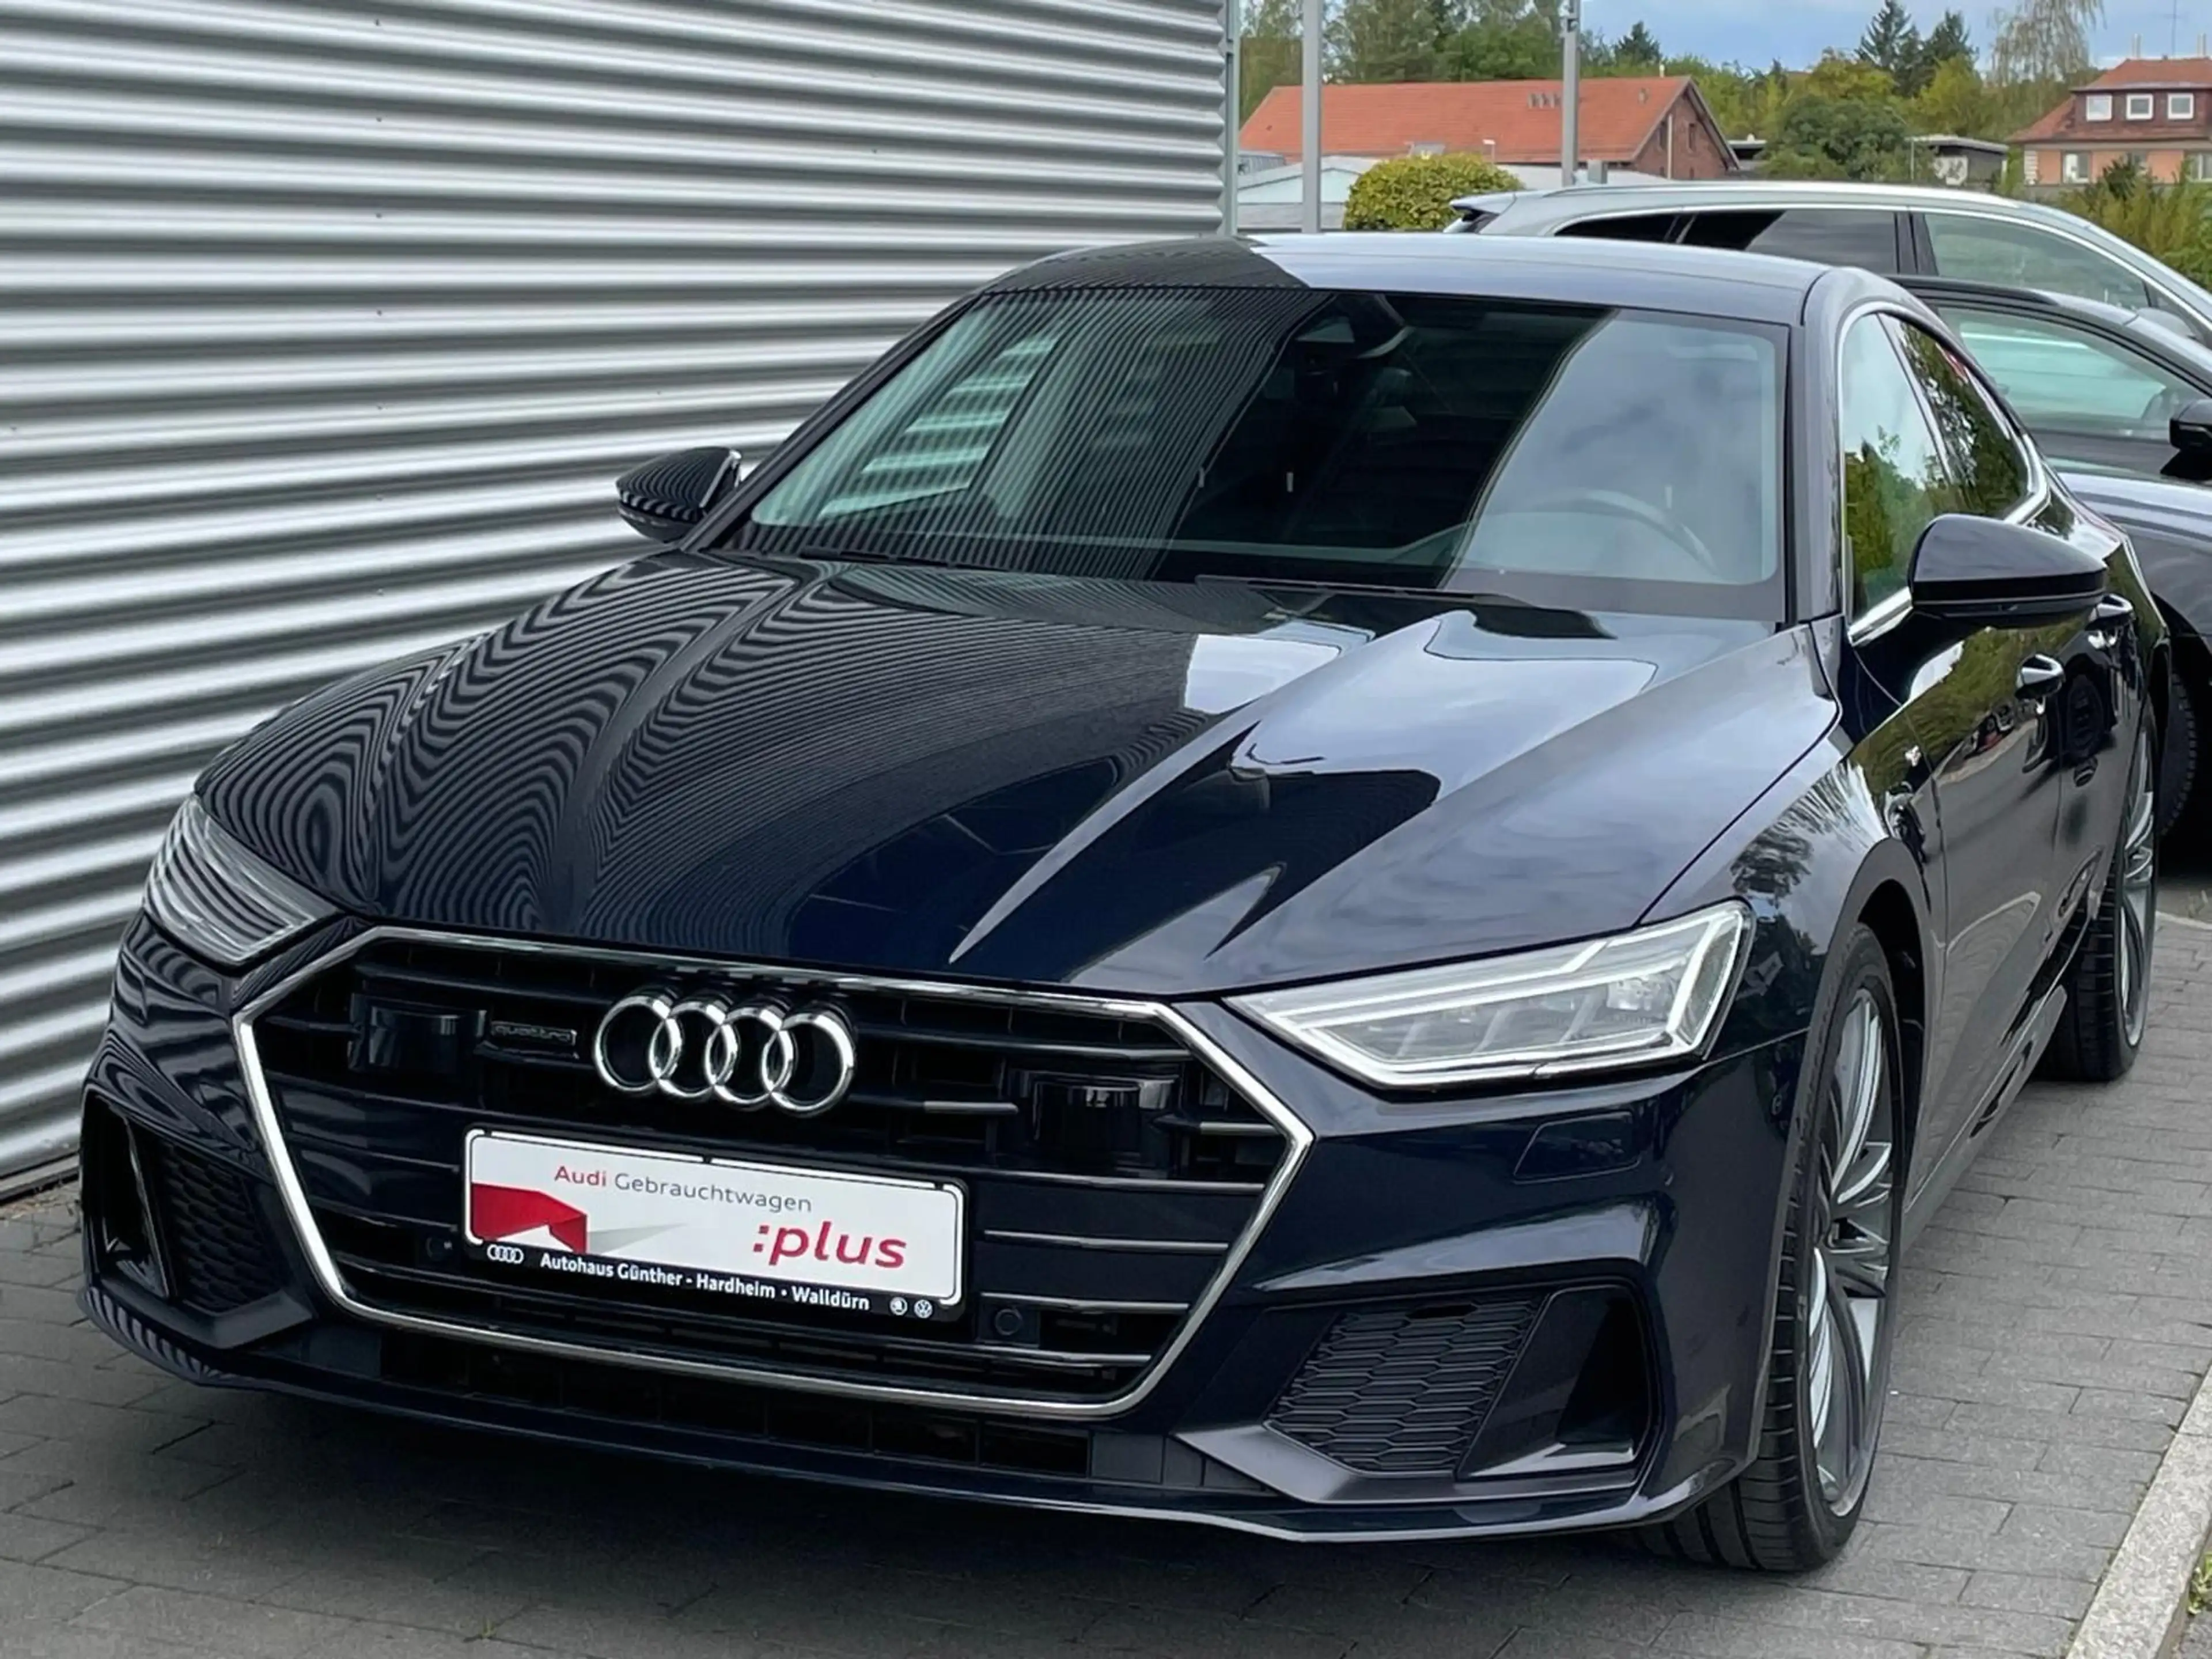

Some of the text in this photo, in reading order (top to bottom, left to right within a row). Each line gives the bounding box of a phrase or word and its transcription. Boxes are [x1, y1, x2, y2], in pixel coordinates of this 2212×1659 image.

[554, 1165, 812, 1214] Audi Gebrauchtwagen
[540, 1252, 613, 1278] Autohaus
[617, 1262, 683, 1286] Günther
[696, 1273, 776, 1299] Hardheim
[791, 1286, 870, 1311] Walldürn
